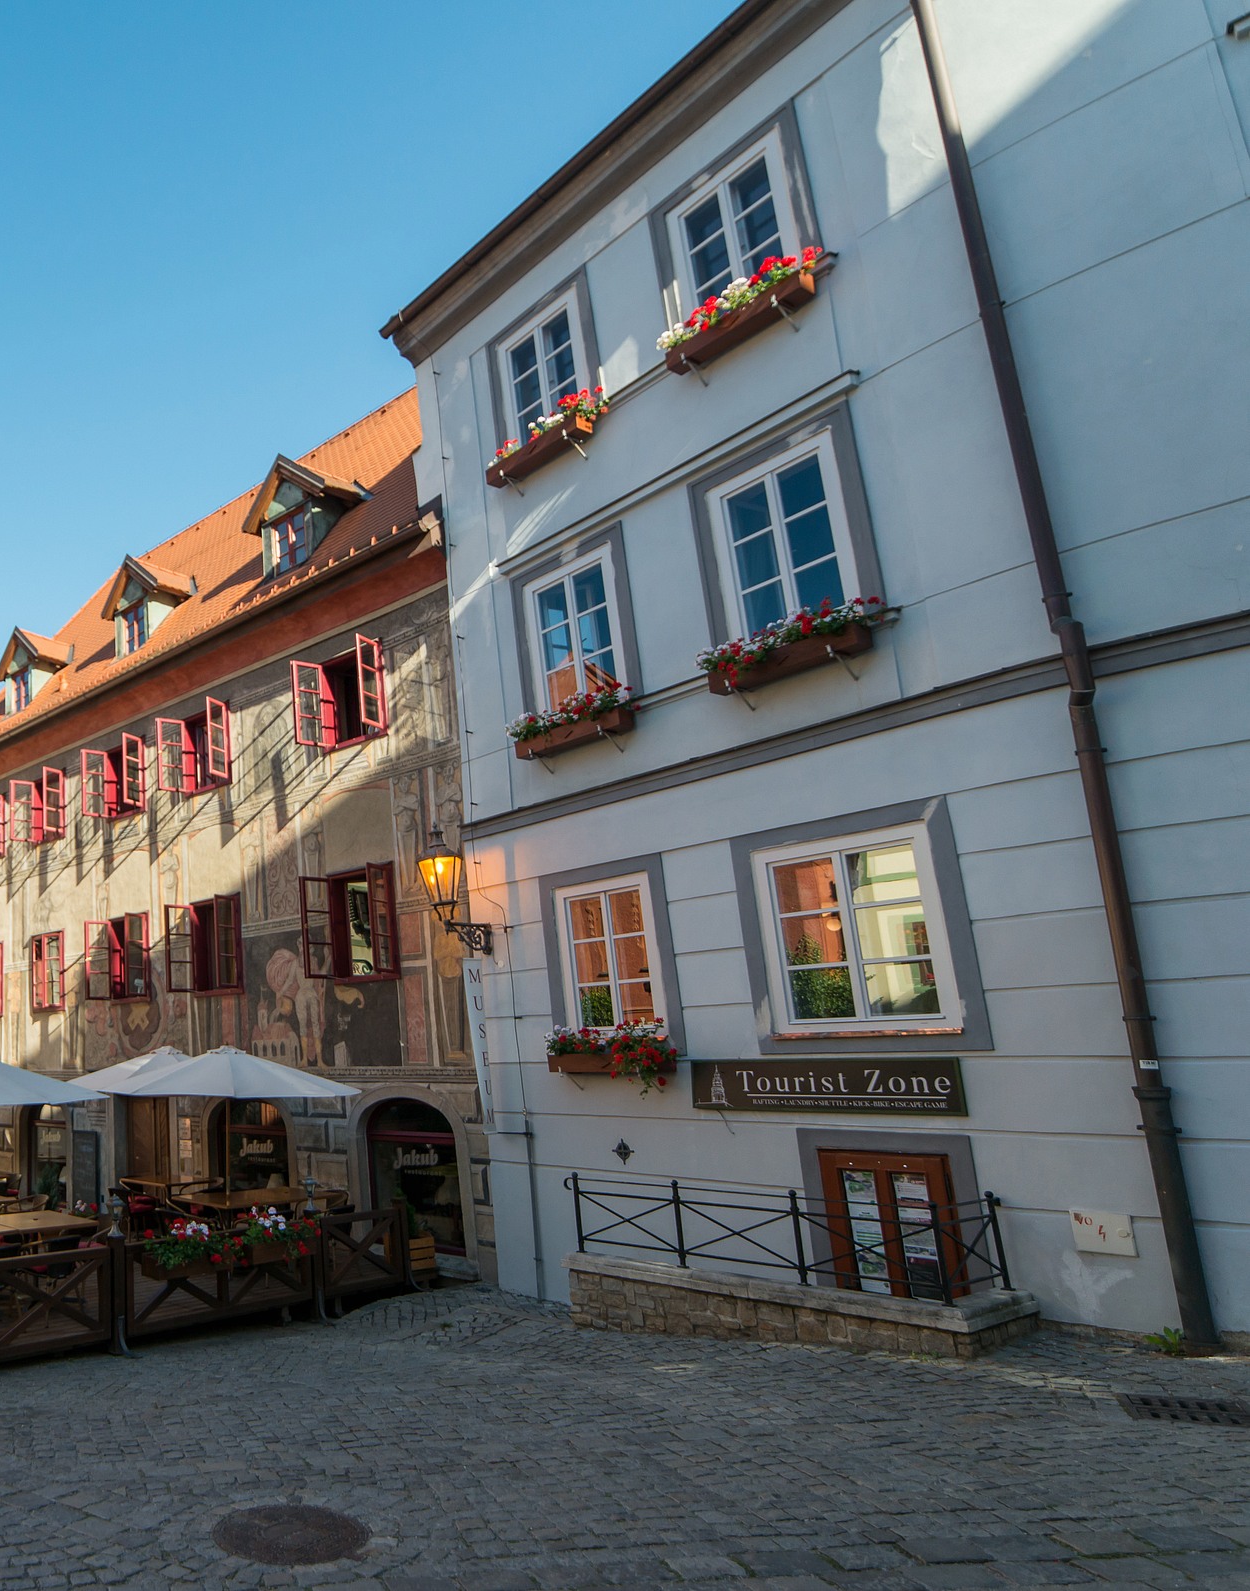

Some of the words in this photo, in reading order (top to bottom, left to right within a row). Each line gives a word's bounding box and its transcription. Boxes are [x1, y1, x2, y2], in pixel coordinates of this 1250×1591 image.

[467, 968, 495, 1125] MUSEUM
[735, 1069, 849, 1093] Tourist
[863, 1069, 951, 1094] Zone
[924, 1101, 948, 1109] GAME
[239, 1137, 274, 1158] Jakub
[392, 1147, 439, 1169] Jakub
